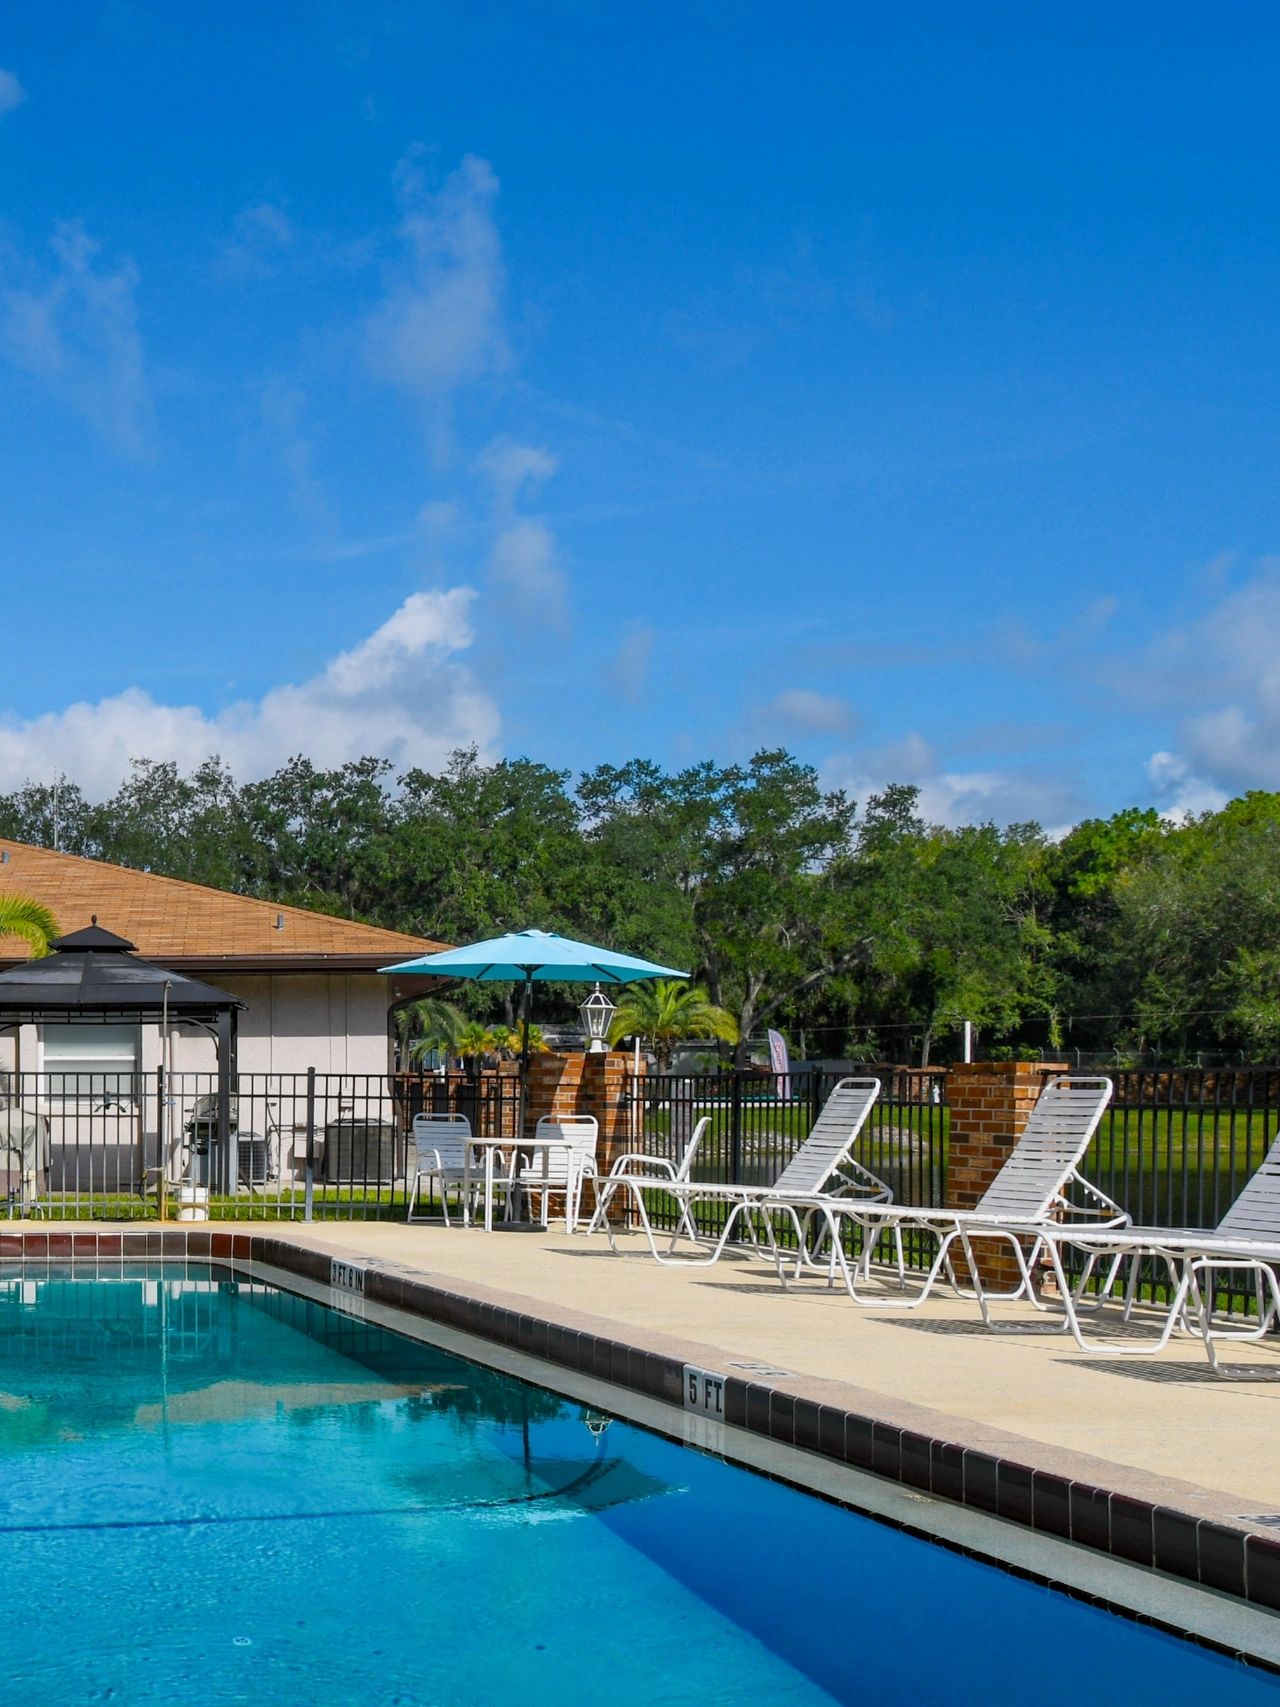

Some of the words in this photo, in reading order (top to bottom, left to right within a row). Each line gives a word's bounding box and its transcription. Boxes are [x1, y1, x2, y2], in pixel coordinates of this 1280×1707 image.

[332, 1263, 337, 1282] 3
[349, 1268, 353, 1288] 6
[689, 1374, 697, 1405] 5
